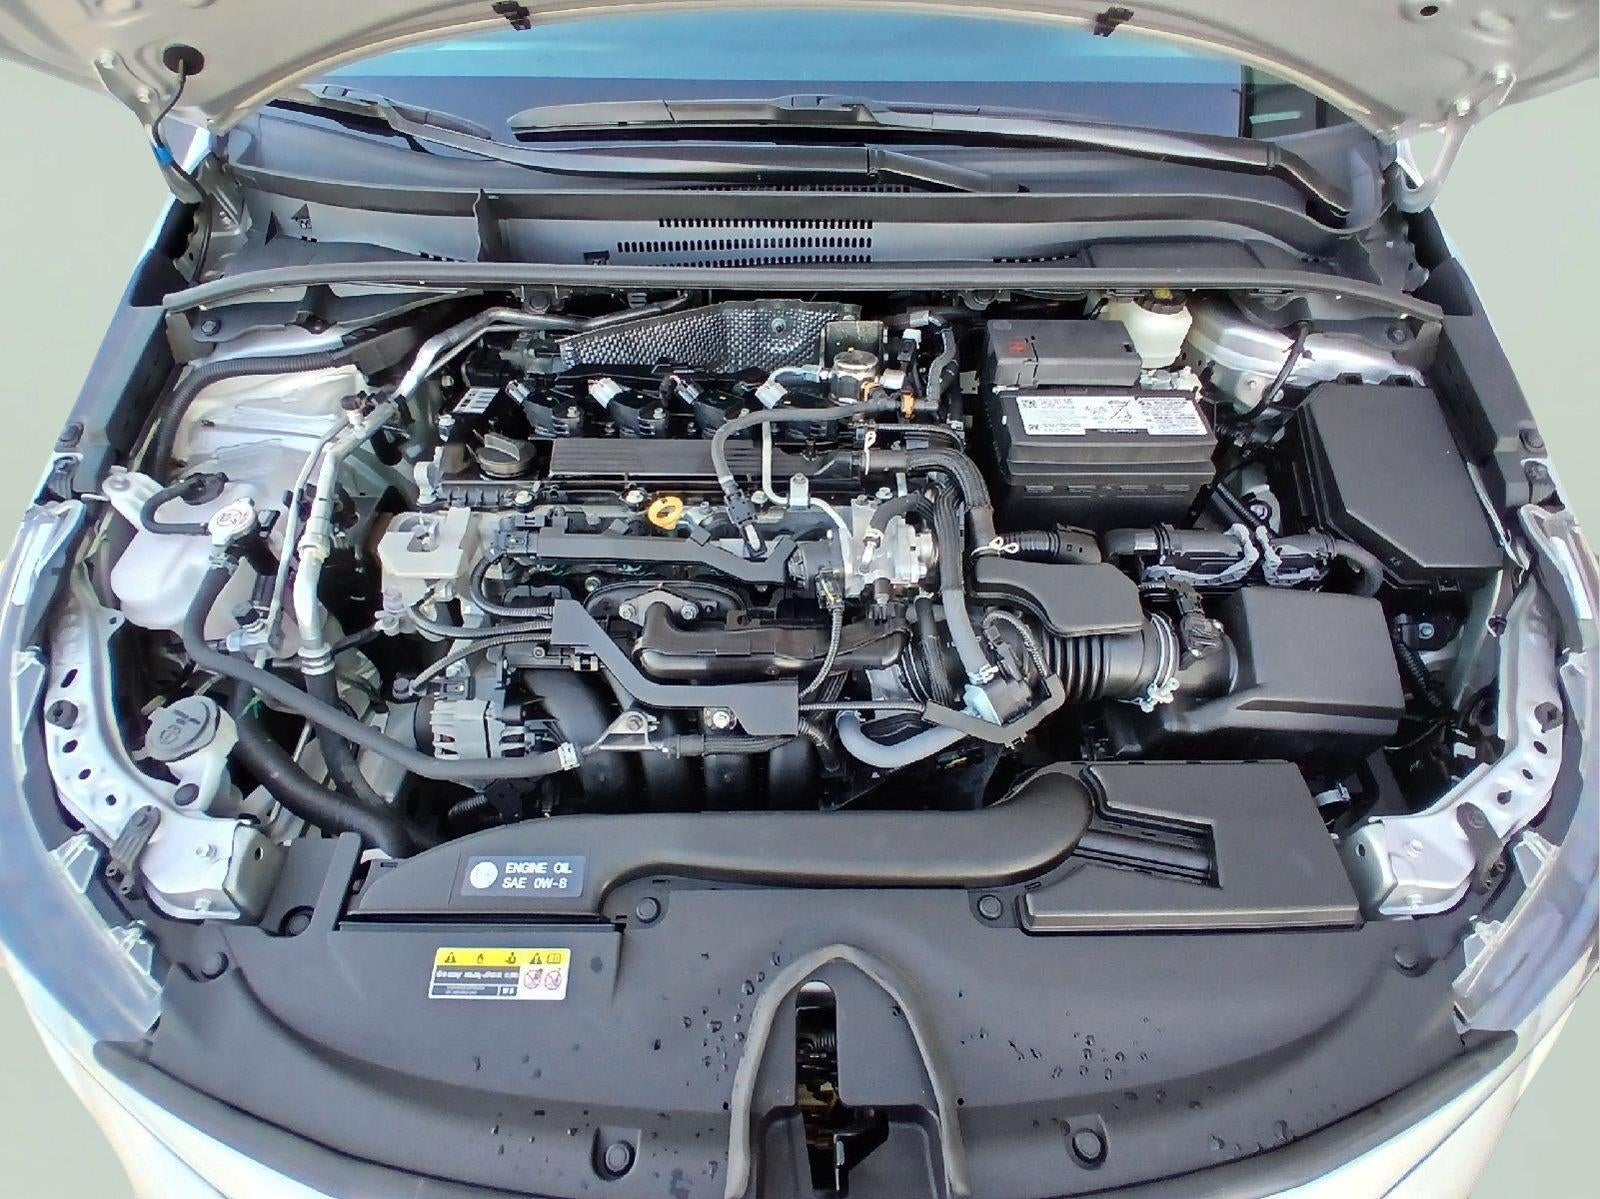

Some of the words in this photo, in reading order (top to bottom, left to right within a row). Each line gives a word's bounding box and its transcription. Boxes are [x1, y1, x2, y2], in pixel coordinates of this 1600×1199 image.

[505, 862, 548, 874] ENGINE
[553, 862, 573, 874] OIL
[502, 877, 527, 889] SAE
[534, 877, 568, 889] 0W-8
